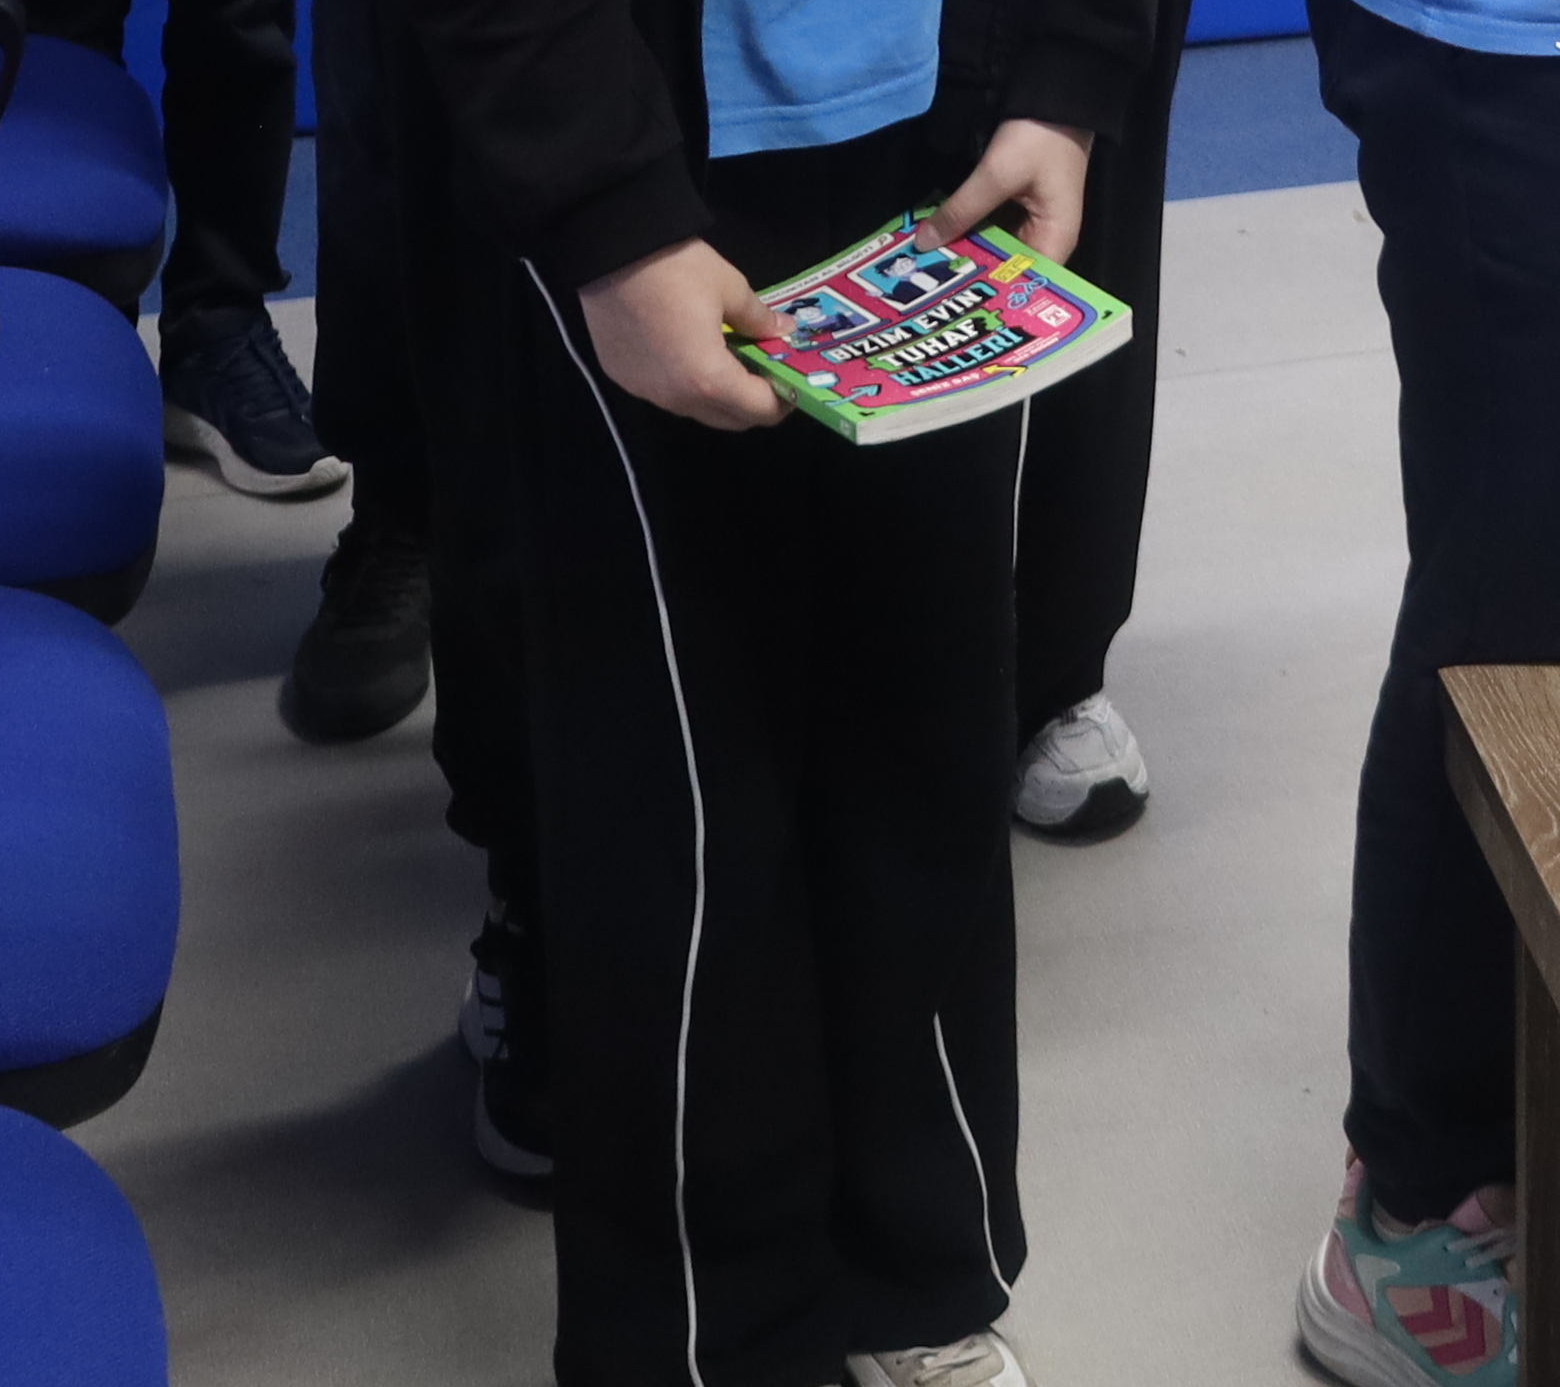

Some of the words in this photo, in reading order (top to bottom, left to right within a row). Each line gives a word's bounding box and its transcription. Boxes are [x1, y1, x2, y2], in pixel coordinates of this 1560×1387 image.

[828, 325, 913, 362] BİZİM
[913, 287, 984, 331] EVİN
[877, 318, 981, 368] TUHAF
[889, 325, 1025, 387] HALLERİ
